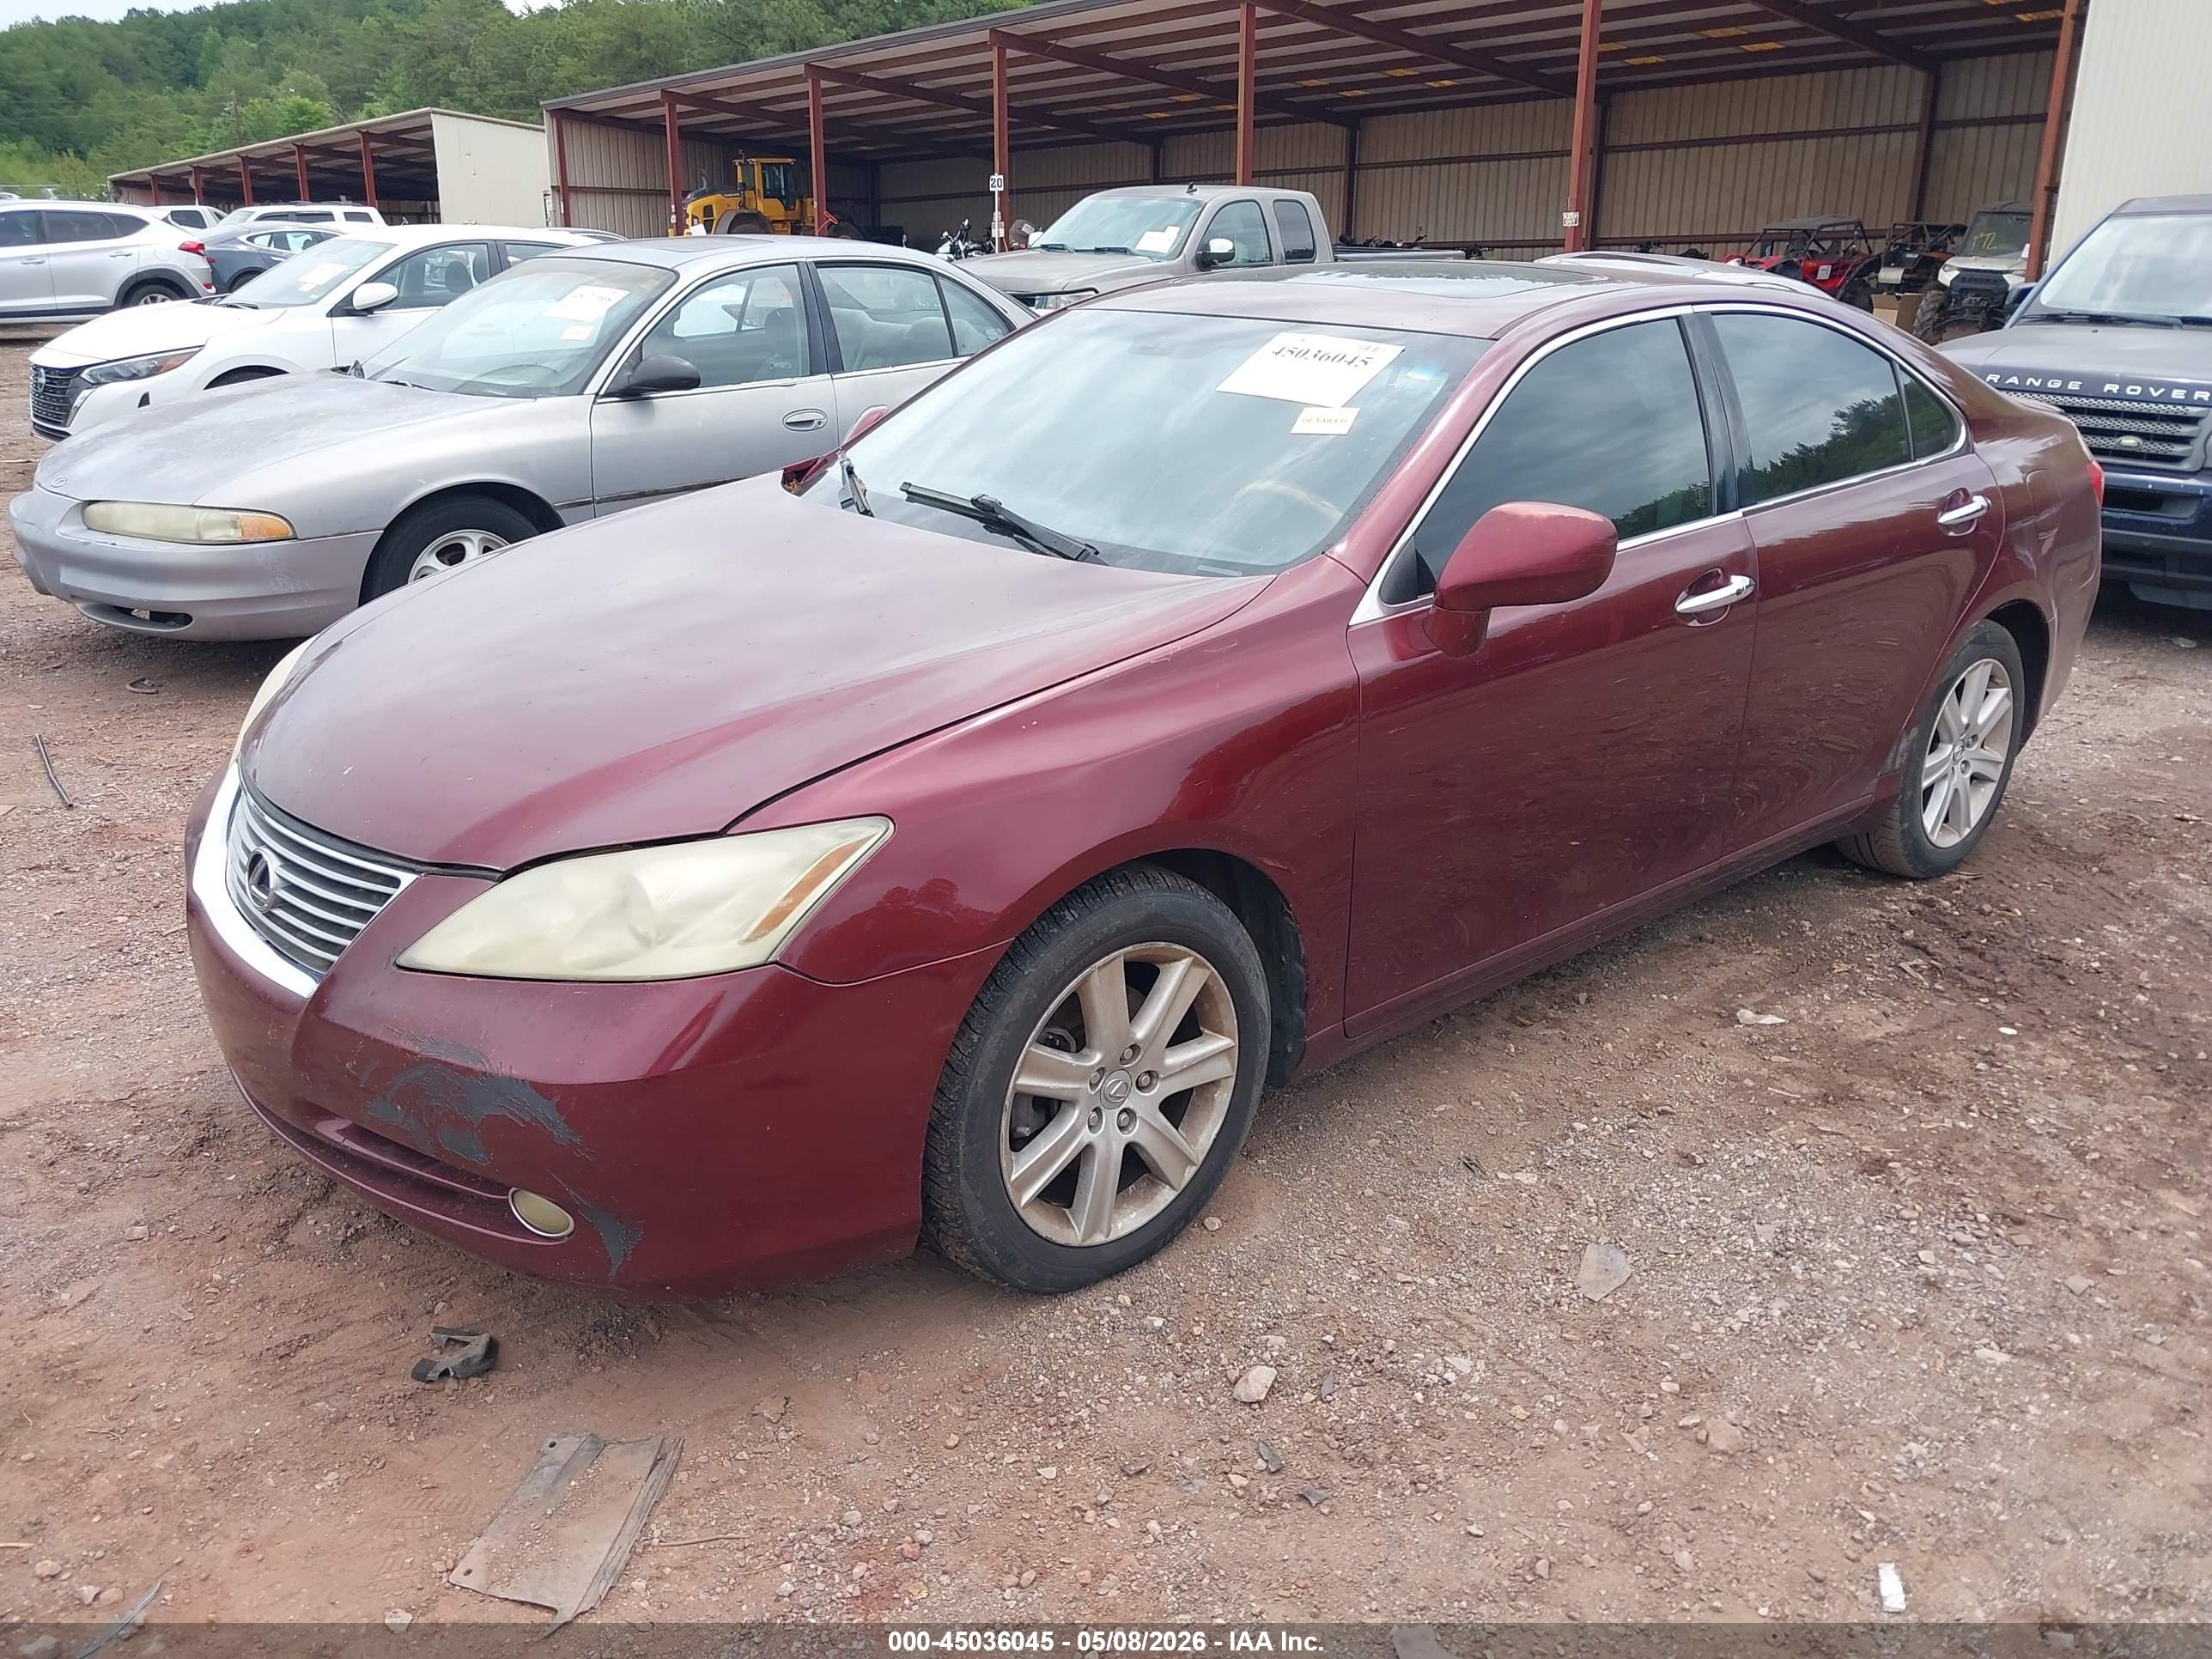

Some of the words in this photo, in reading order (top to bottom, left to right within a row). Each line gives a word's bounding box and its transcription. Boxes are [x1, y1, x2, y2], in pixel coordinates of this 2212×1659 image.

[991, 178, 1003, 188] 20
[1272, 345, 1374, 368] 45036045
[1985, 374, 2083, 391] RANGE
[2104, 384, 2212, 401] ROVER
